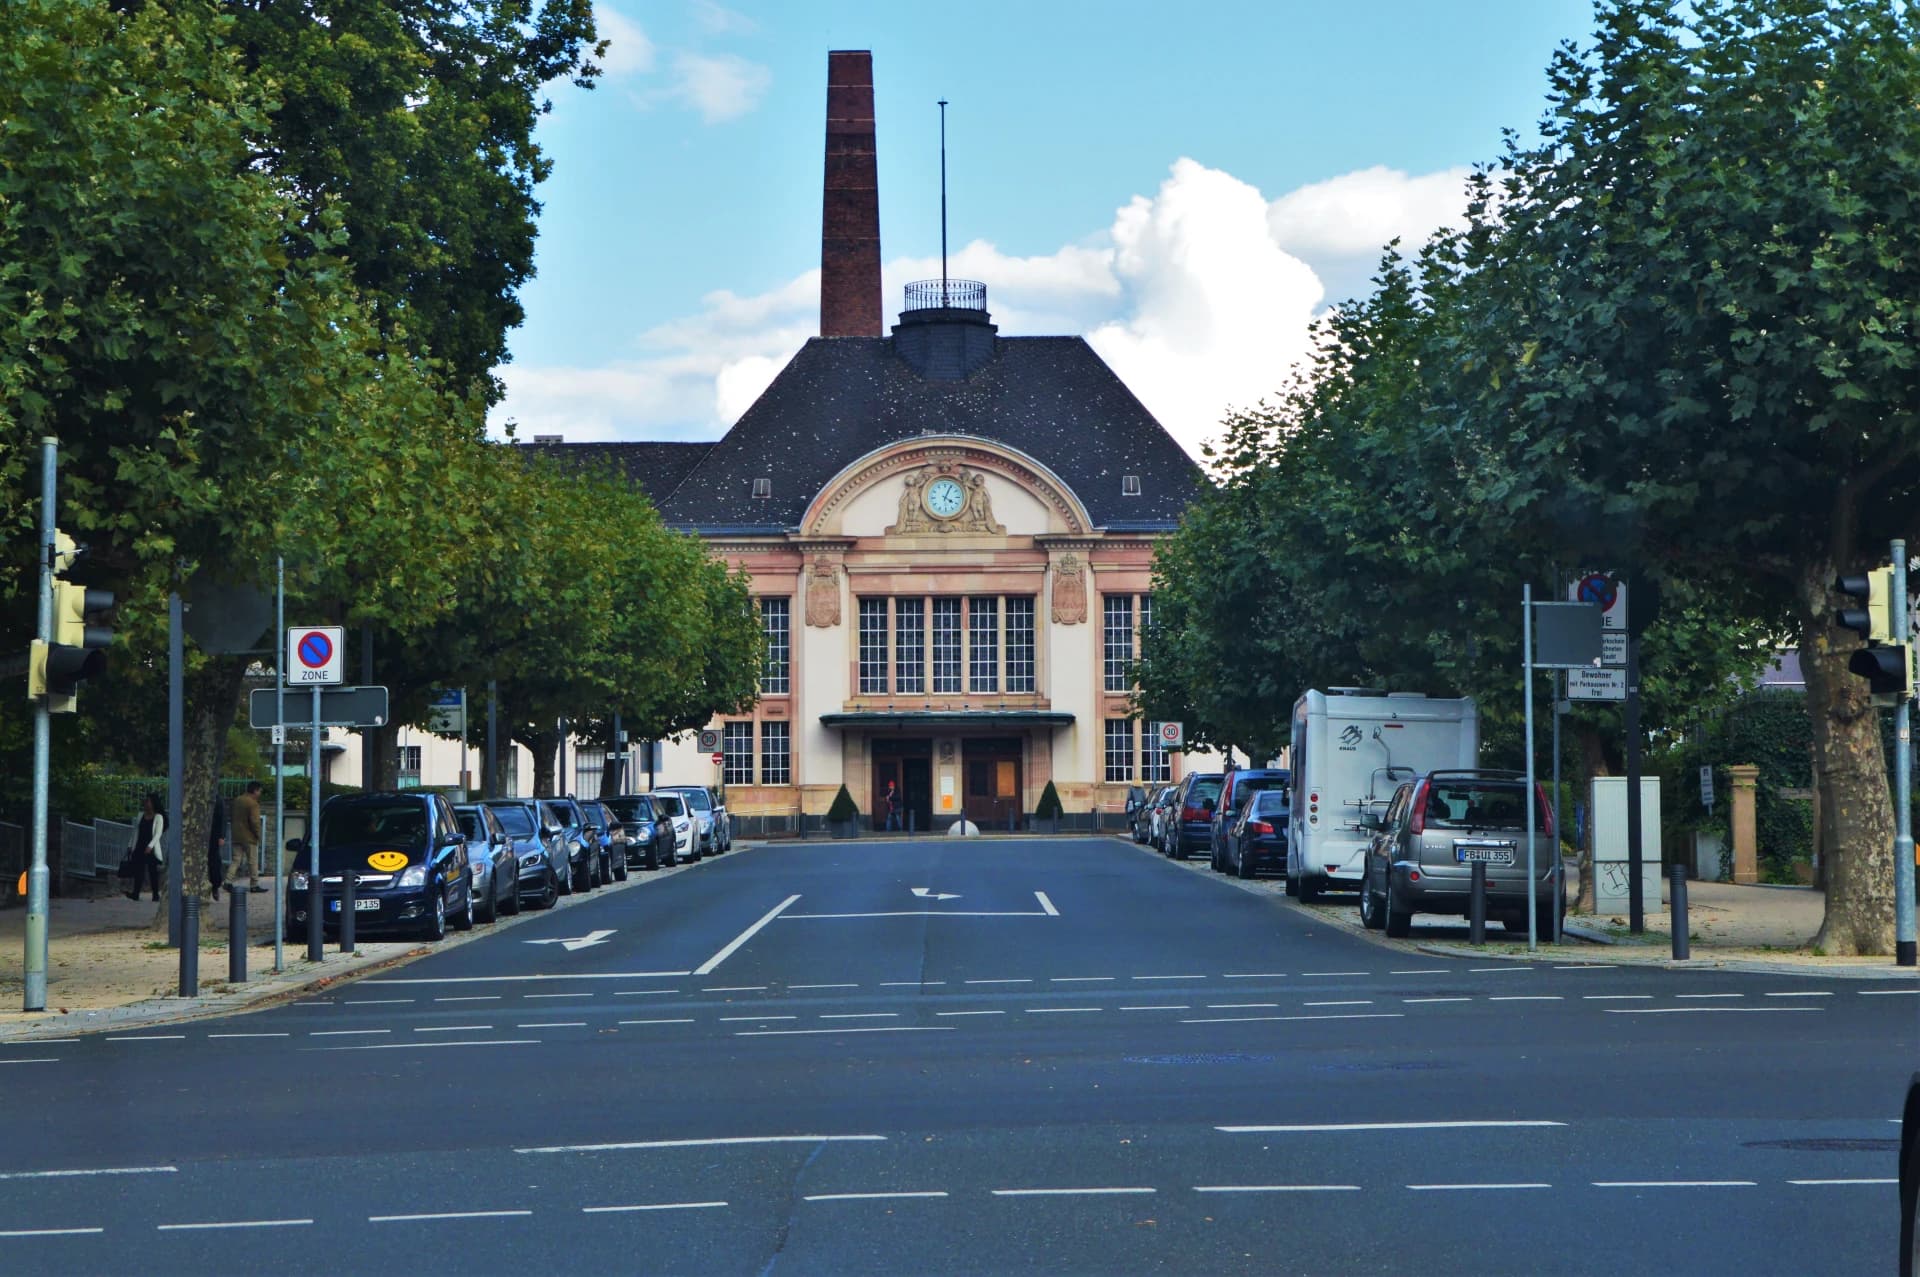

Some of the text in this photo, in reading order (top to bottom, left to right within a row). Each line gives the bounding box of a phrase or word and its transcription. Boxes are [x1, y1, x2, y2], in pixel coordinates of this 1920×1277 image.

[302, 671, 328, 680] ZONE
[1582, 670, 1612, 679] Bewohner
[1591, 689, 1603, 697] frei
[1166, 728, 1176, 736] 30
[705, 735, 715, 744] 30
[1493, 851, 1510, 861] 355
[364, 900, 379, 909] 135
